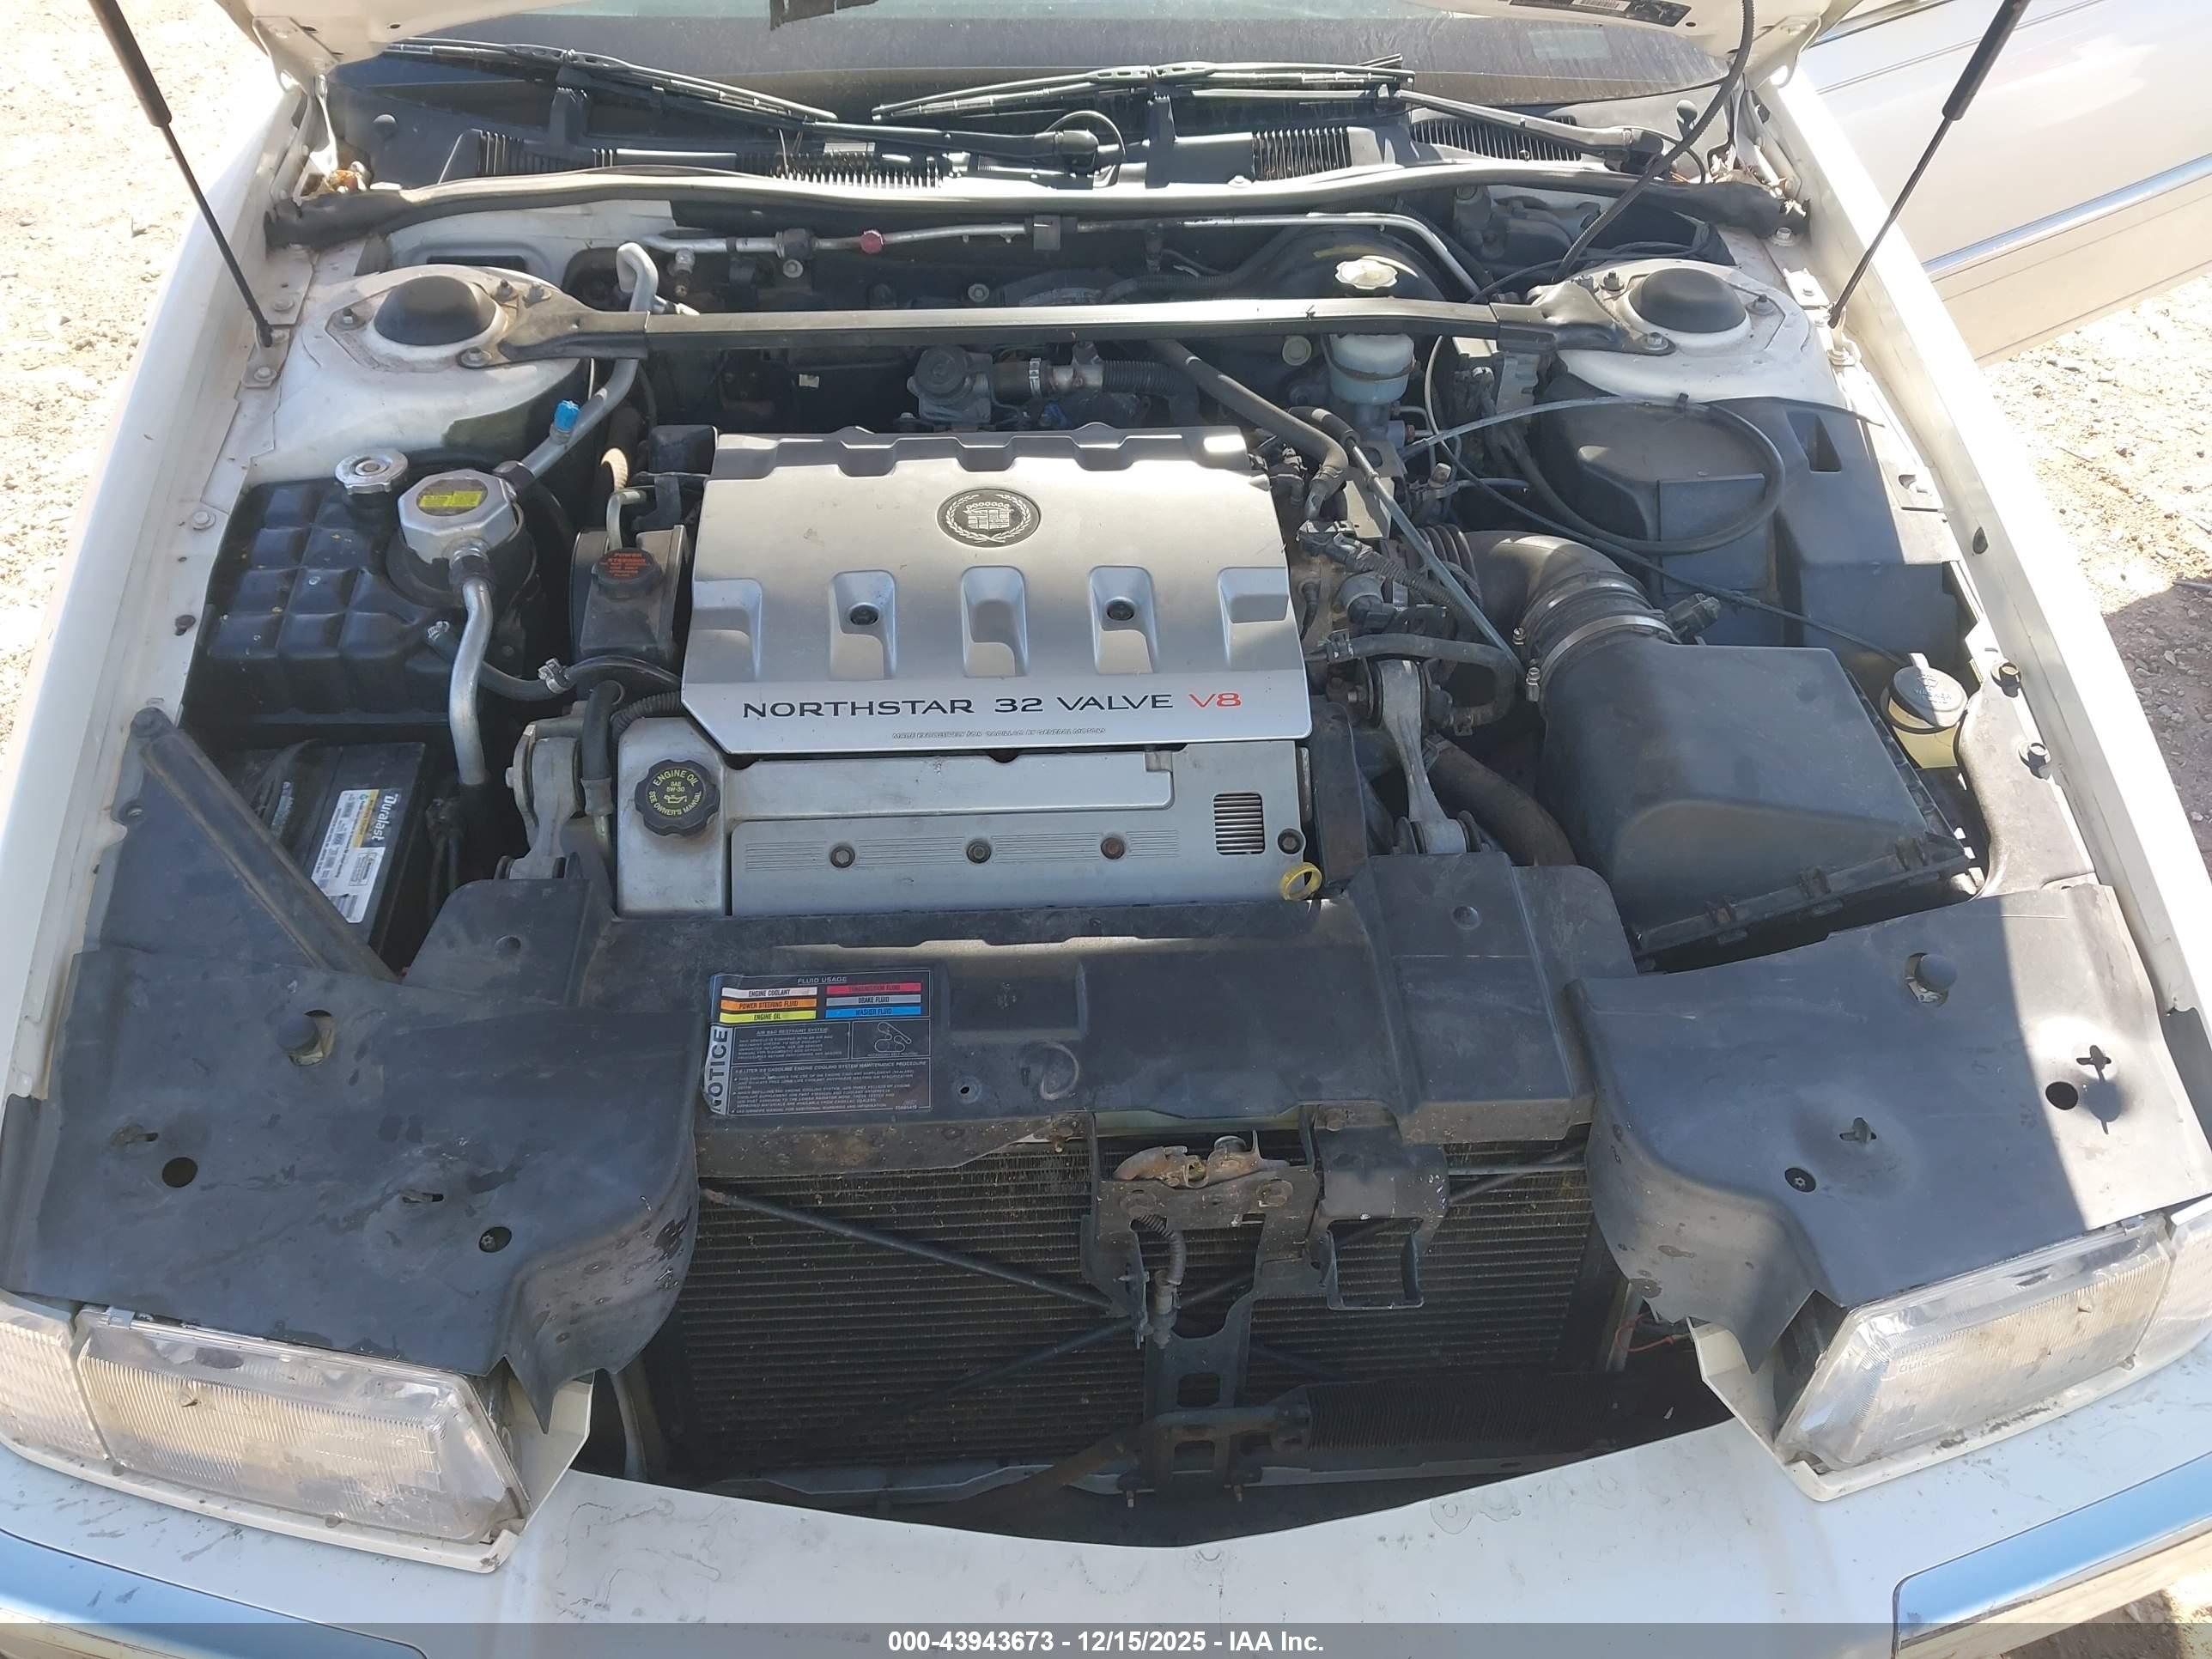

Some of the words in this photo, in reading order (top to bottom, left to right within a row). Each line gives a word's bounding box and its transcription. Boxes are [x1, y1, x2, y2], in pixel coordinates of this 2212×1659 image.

[743, 698, 975, 718] NORTHSTAR
[994, 697, 1044, 713] 32
[1056, 694, 1174, 711] VALVE
[1188, 692, 1243, 708] V8
[653, 769, 687, 786] ENGINE
[686, 774, 699, 787] OIL
[648, 791, 658, 804] SEE
[683, 790, 702, 813] MANUAL
[371, 793, 398, 841] Duralast
